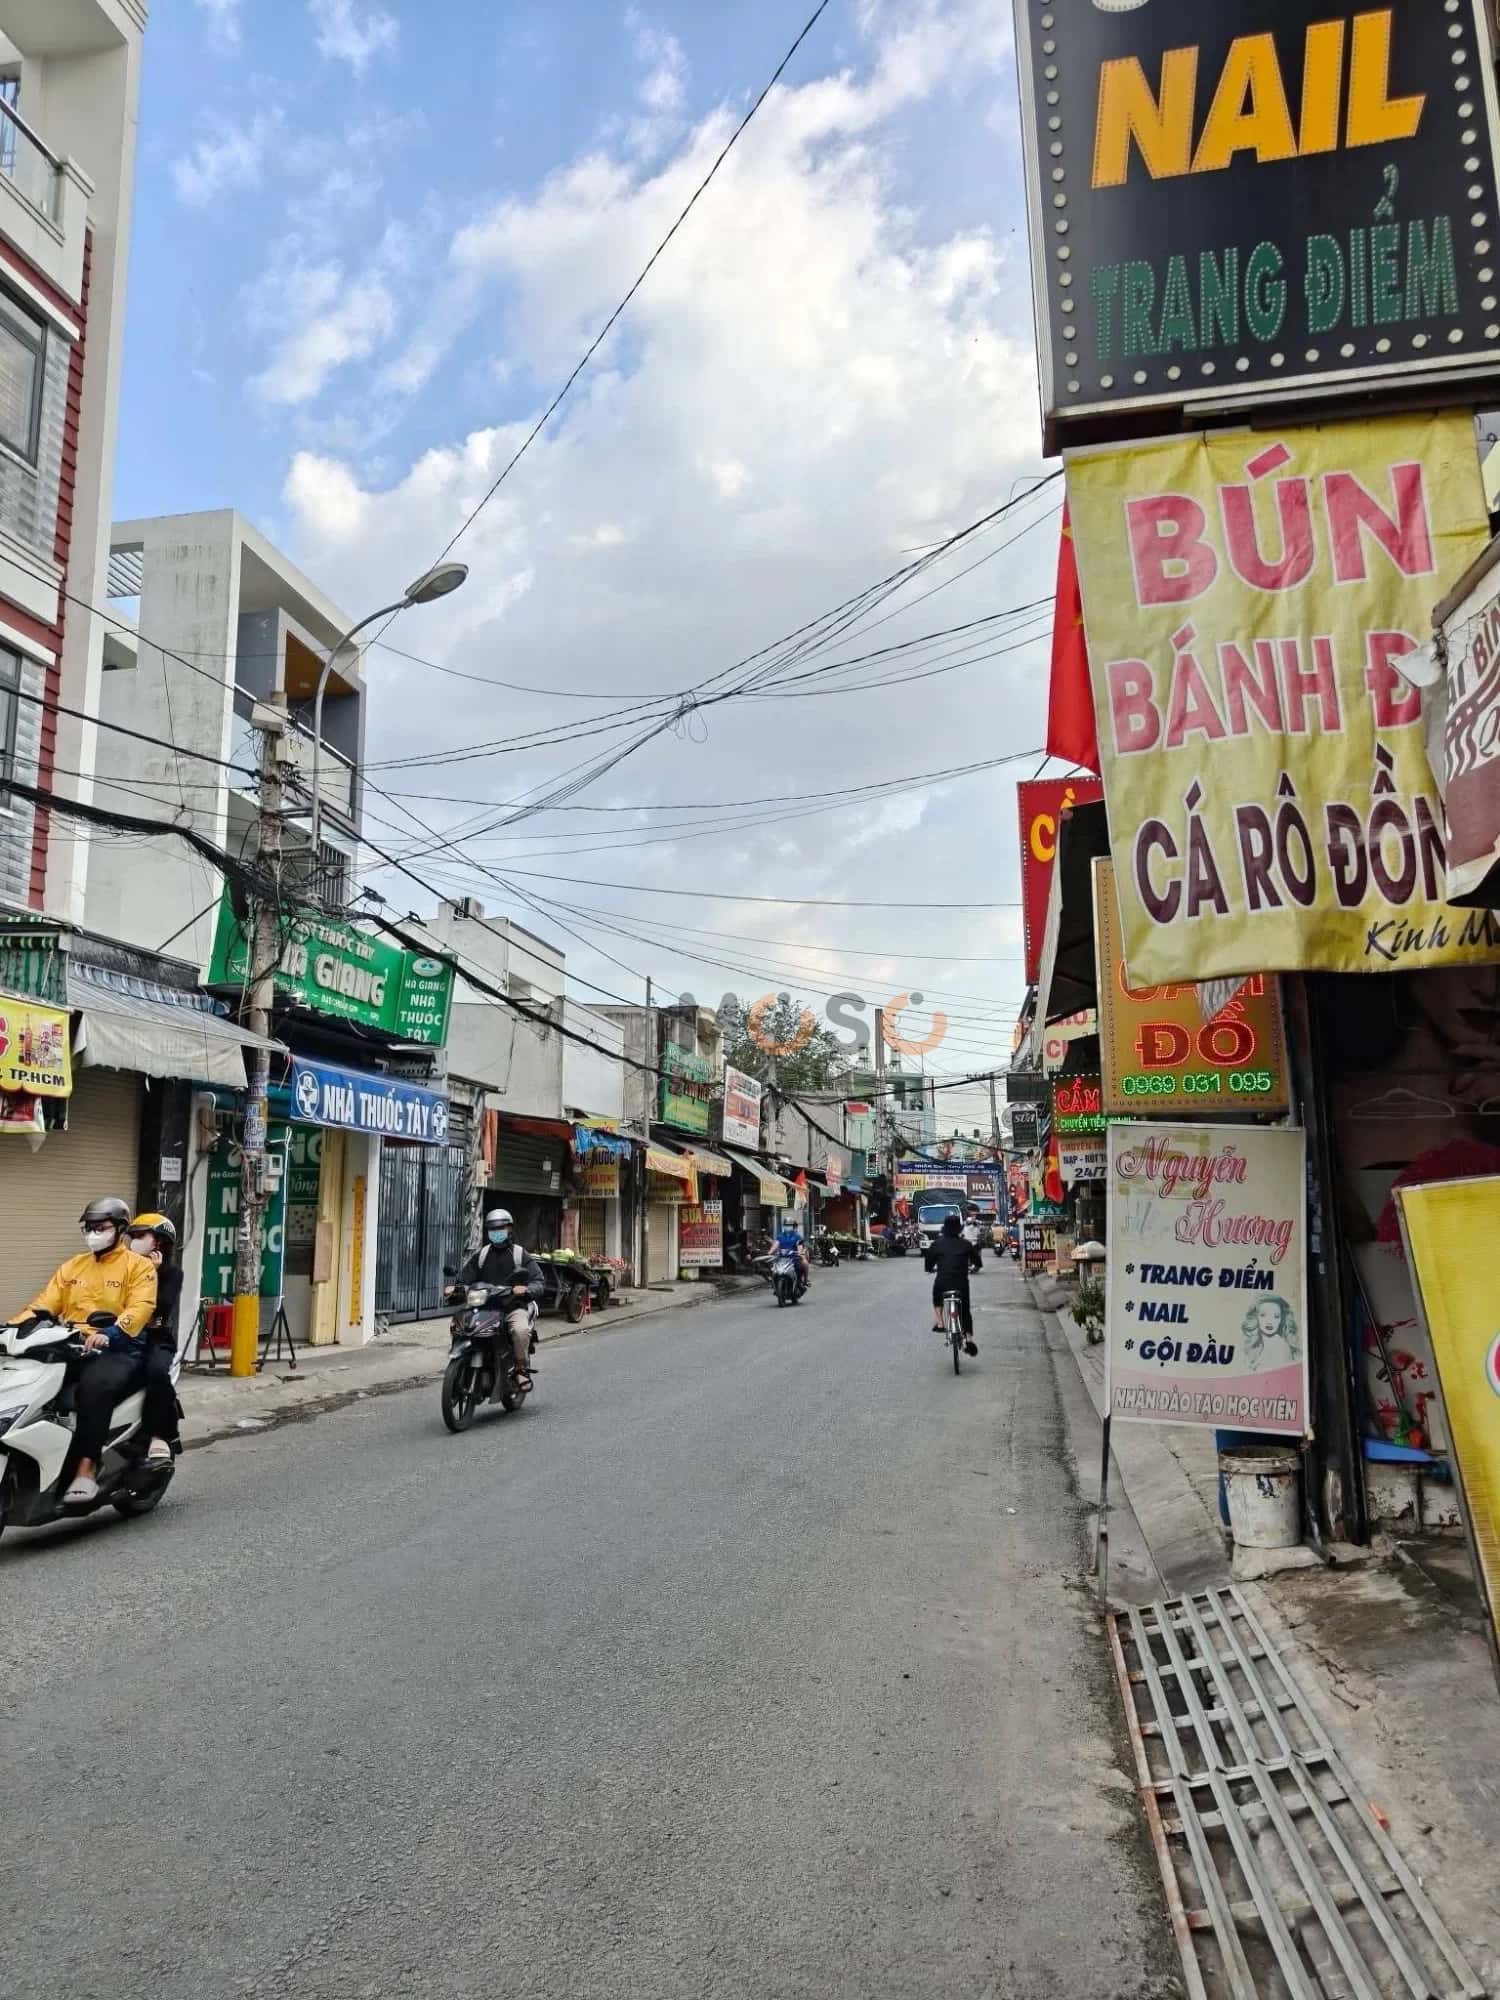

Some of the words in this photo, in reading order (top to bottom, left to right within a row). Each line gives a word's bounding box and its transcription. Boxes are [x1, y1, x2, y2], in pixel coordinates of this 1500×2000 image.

[1091, 9, 1426, 188] NAIL
[1089, 241, 1286, 359] TRANG
[1304, 164, 1458, 334] ĐIỂM
[1126, 442, 1435, 606] BÚN
[1107, 624, 1341, 755] BÁNH
[1366, 631, 1424, 728] Đ
[1135, 780, 1231, 924] CÁ
[1236, 774, 1316, 912] RÔ
[1327, 742, 1447, 908] ĐỒN
[1365, 919, 1450, 961] Kính
[10, 1068, 66, 1087] TP.HCM
[1122, 1074, 1176, 1095] 0969
[1182, 1073, 1222, 1093] 031
[1228, 1071, 1272, 1093] 095
[322, 1082, 355, 1123] NHÀ
[359, 1087, 404, 1131] THUỐC
[406, 1097, 430, 1136] TÂY
[1116, 1136, 1248, 1200] Nguyễn
[1176, 1199, 1295, 1265] Hương
[1139, 1264, 1213, 1287] TRANG
[1218, 1258, 1274, 1290] ĐIỂM
[1138, 1302, 1189, 1323] NAIL
[1139, 1337, 1181, 1366] GỘI
[1186, 1334, 1235, 1365] ĐẦU
[1113, 1384, 1157, 1416] NHẬN
[1192, 1393, 1225, 1421] TẠO
[1226, 1394, 1259, 1424] HỌC
[1261, 1394, 1298, 1421] VIÊN
